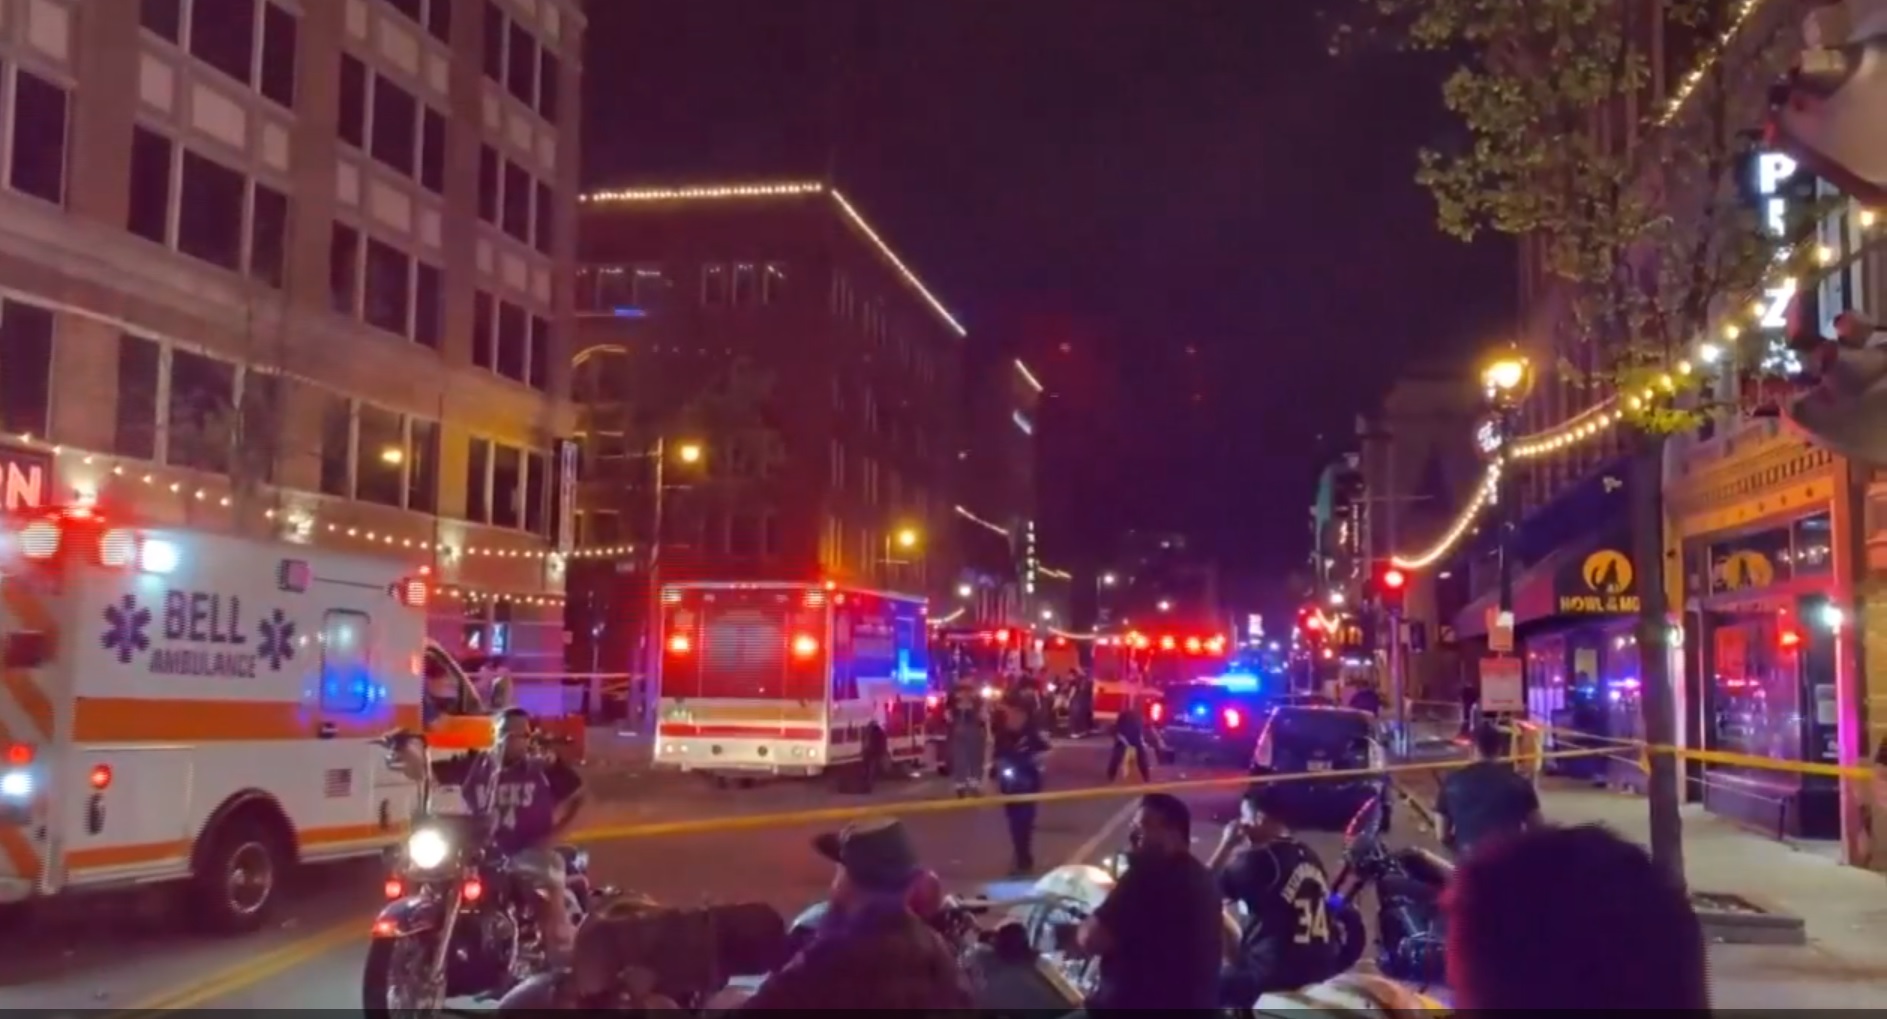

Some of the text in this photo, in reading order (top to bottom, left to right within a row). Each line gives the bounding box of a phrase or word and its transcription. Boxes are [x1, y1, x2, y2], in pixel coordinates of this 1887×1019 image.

[1759, 153, 1802, 374] PIZ
[0, 460, 42, 510] N
[165, 590, 247, 644] BELL
[1560, 595, 1604, 612] HOWL
[1619, 595, 1641, 612] MO
[149, 648, 256, 678] AMBULANCE
[1293, 898, 1330, 944] 34
